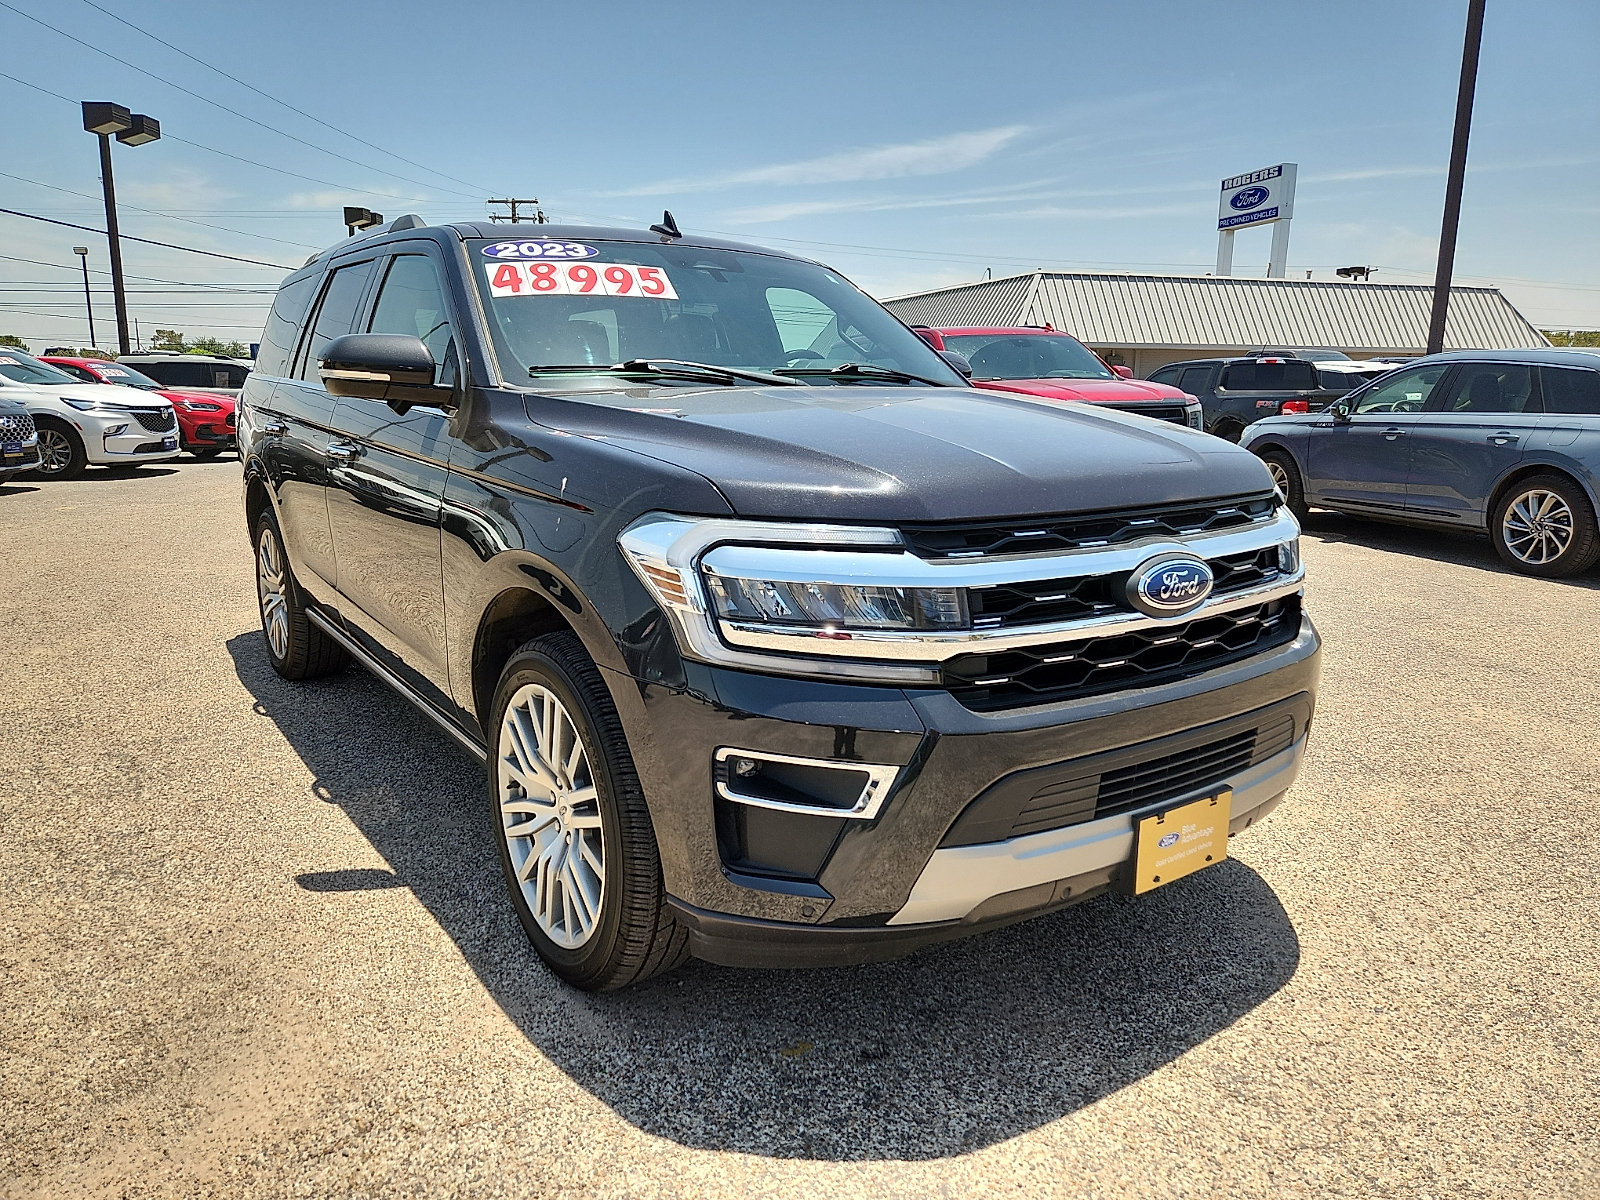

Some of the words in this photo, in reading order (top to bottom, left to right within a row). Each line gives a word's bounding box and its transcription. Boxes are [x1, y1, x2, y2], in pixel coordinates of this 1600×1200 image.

[1223, 167, 1279, 189] ROGERS
[1236, 189, 1261, 207] Ford
[1250, 209, 1277, 221] VEHICLES
[495, 242, 589, 257] 2023
[492, 262, 666, 295] 48995
[1160, 569, 1200, 600] Ford
